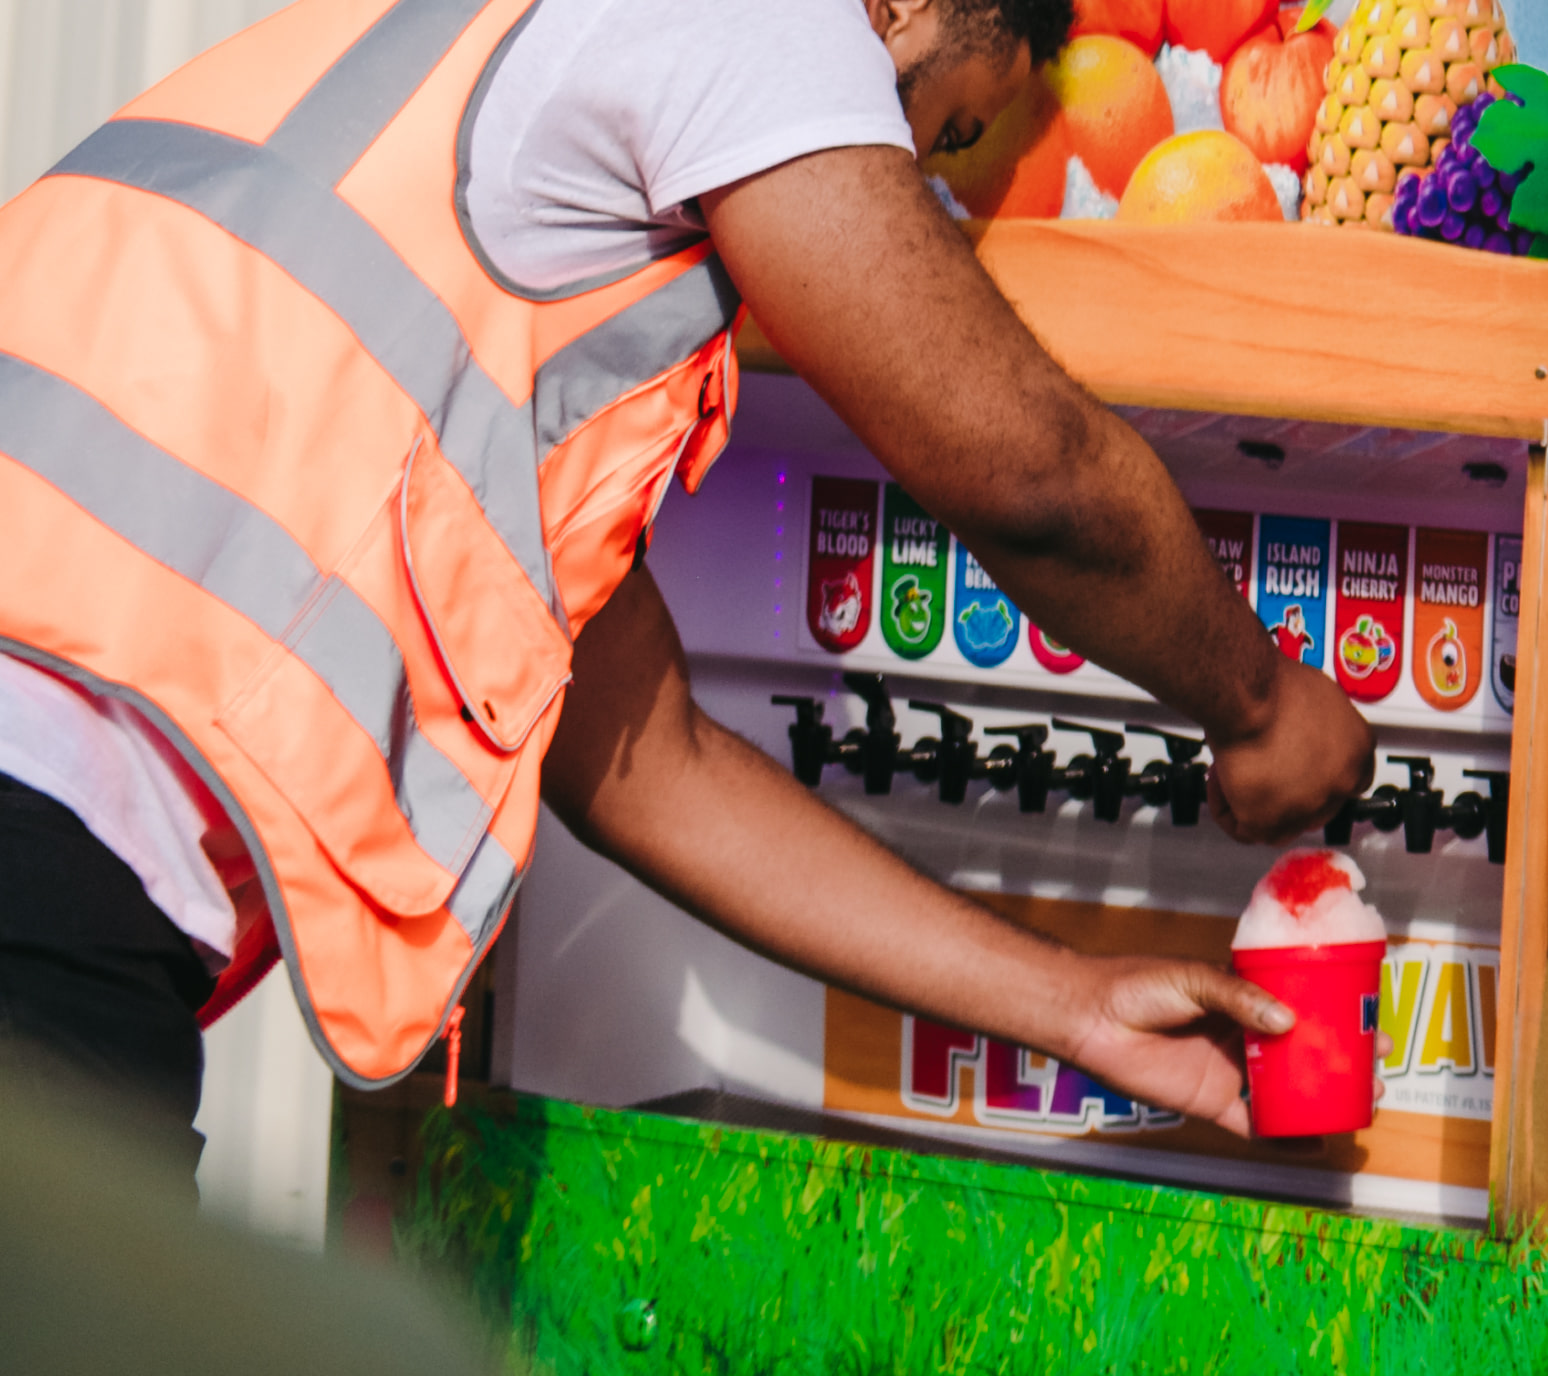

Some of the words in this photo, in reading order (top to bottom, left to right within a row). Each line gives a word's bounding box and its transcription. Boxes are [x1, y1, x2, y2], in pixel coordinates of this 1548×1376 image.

[818, 508, 870, 531] TIGER'S
[894, 516, 939, 537] LUCKY
[816, 530, 869, 558] BLOOD
[892, 538, 938, 567] LIME
[1267, 542, 1321, 566] ISLAND
[1343, 549, 1399, 577] NINJA
[1421, 563, 1479, 584] MONSTER
[1265, 564, 1320, 598] RUSH
[1341, 576, 1399, 602] CHERRY
[1420, 581, 1479, 608] MANGO
